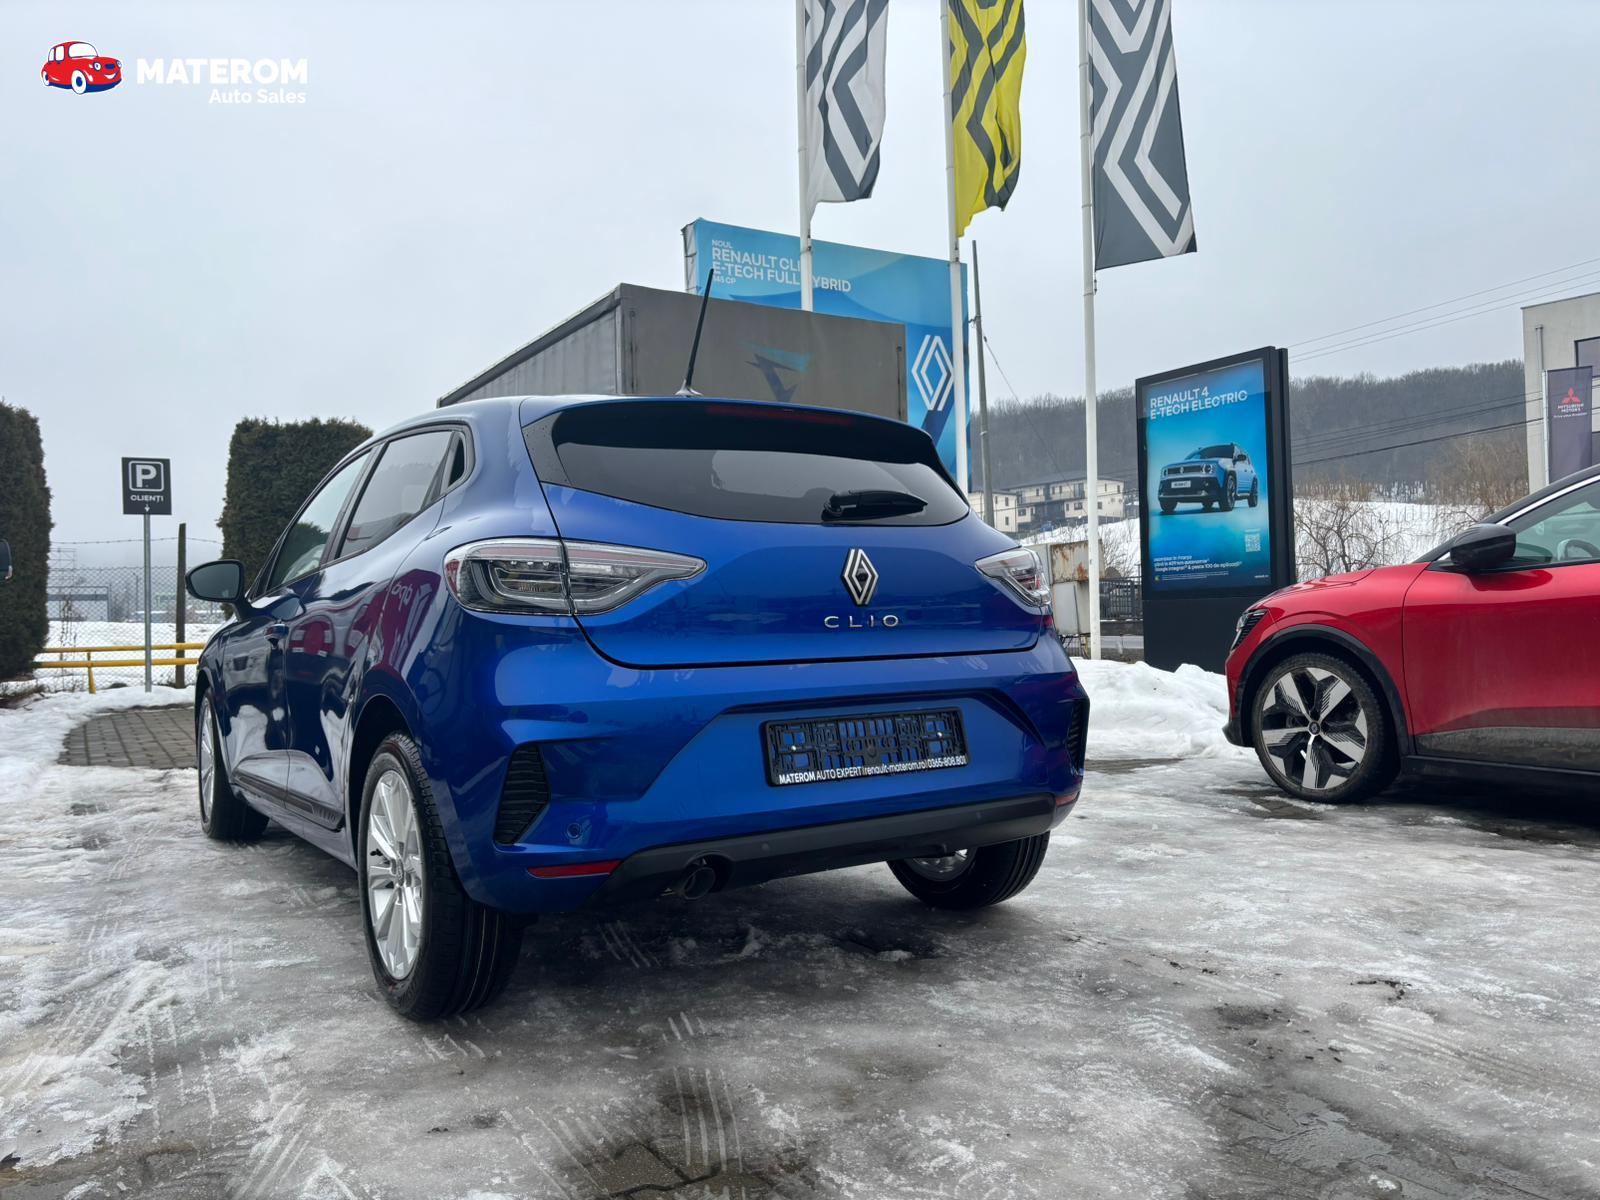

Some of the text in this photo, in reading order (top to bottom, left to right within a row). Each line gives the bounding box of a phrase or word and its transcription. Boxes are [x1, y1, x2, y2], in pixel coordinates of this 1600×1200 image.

[712, 248, 800, 272] RENAULT CLI
[712, 261, 851, 292] E-TECH FULL YBRID
[1150, 386, 1209, 408] RENAULT 4
[1150, 390, 1248, 420] E-TECH ELECTRIC
[824, 615, 899, 629] CLIO
[779, 771, 816, 785] MATEROM
[816, 768, 836, 780] AUTO
[836, 766, 862, 778] EXPERT
